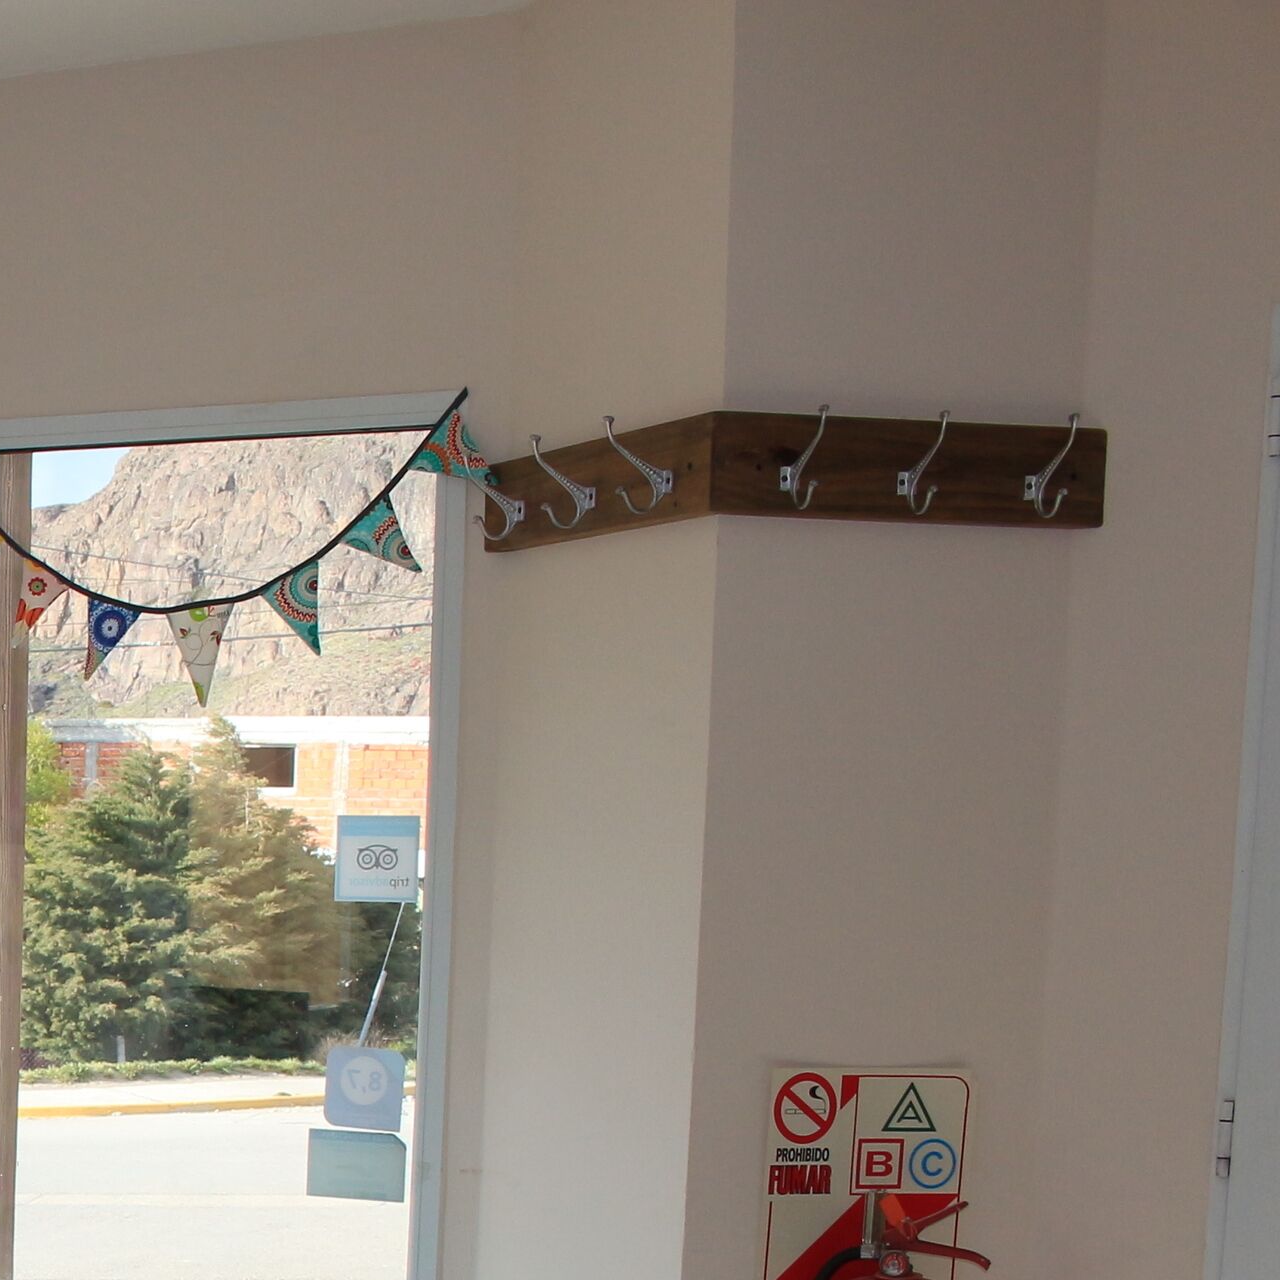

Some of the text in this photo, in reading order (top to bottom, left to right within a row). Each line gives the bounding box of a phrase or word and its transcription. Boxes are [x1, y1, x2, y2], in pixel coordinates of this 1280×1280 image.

[896, 1100, 924, 1124] A
[776, 1147, 830, 1162] PROHIBIDO
[865, 1151, 944, 1177] B C
[768, 1165, 832, 1195] FUMAR
